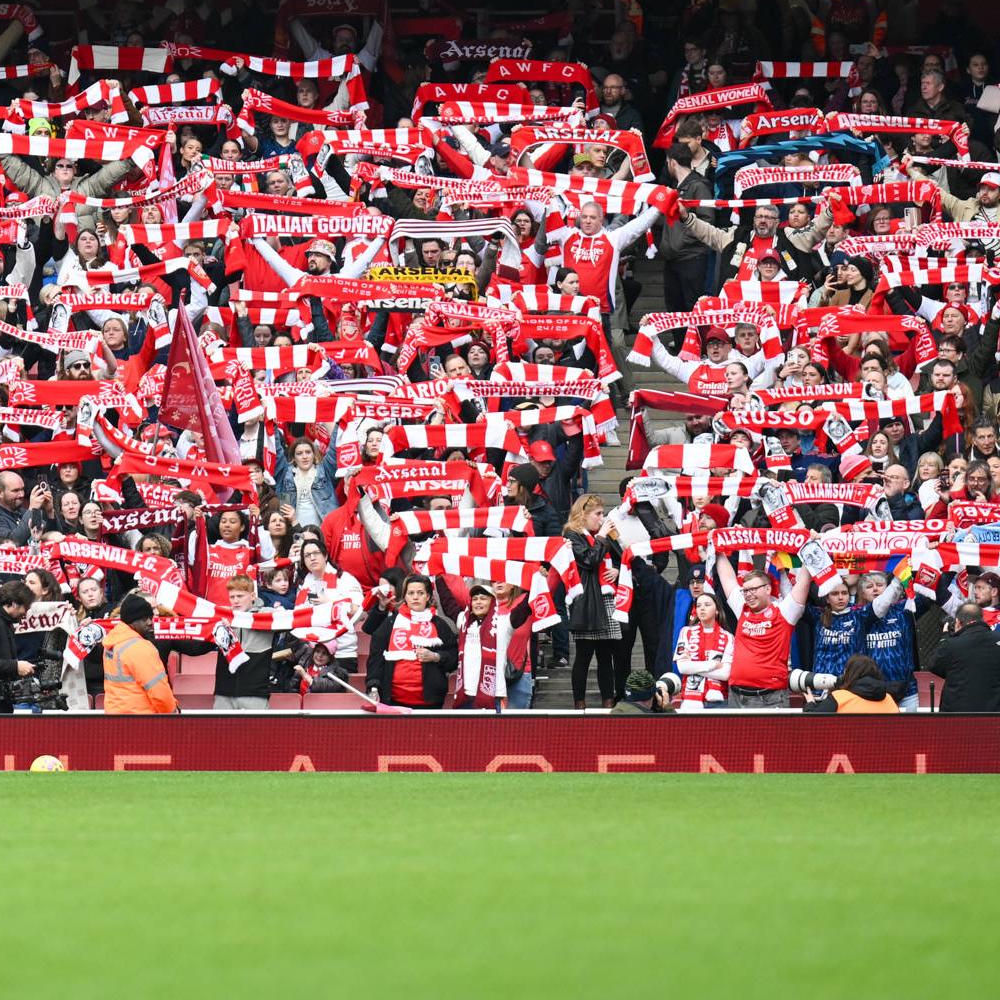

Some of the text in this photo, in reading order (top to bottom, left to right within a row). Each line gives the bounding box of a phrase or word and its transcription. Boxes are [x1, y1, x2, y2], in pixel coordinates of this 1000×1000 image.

[717, 85, 760, 103] WOMEN
[838, 112, 912, 130] ARSENAL
[534, 128, 620, 143] ARSENAL
[740, 171, 820, 190] SUPPORTERS
[252, 214, 392, 235] ITALIAN GOONERS
[379, 266, 470, 276] ARSENAL
[65, 292, 148, 307] ZINSBERGER
[472, 387, 561, 398] SUPPORTERS
[768, 382, 853, 399] WILLIAMSON
[735, 411, 814, 426] RUSSO
[374, 463, 447, 482] Arsenal
[790, 484, 853, 500] WILLIAMSON
[857, 520, 944, 533] RUSSO
[716, 531, 805, 548] ALESSIA RUSSO
[823, 536, 909, 551] WFC
[59, 541, 123, 562] ARSENAL
[153, 622, 204, 636] LLY
[865, 630, 902, 641] mirates
